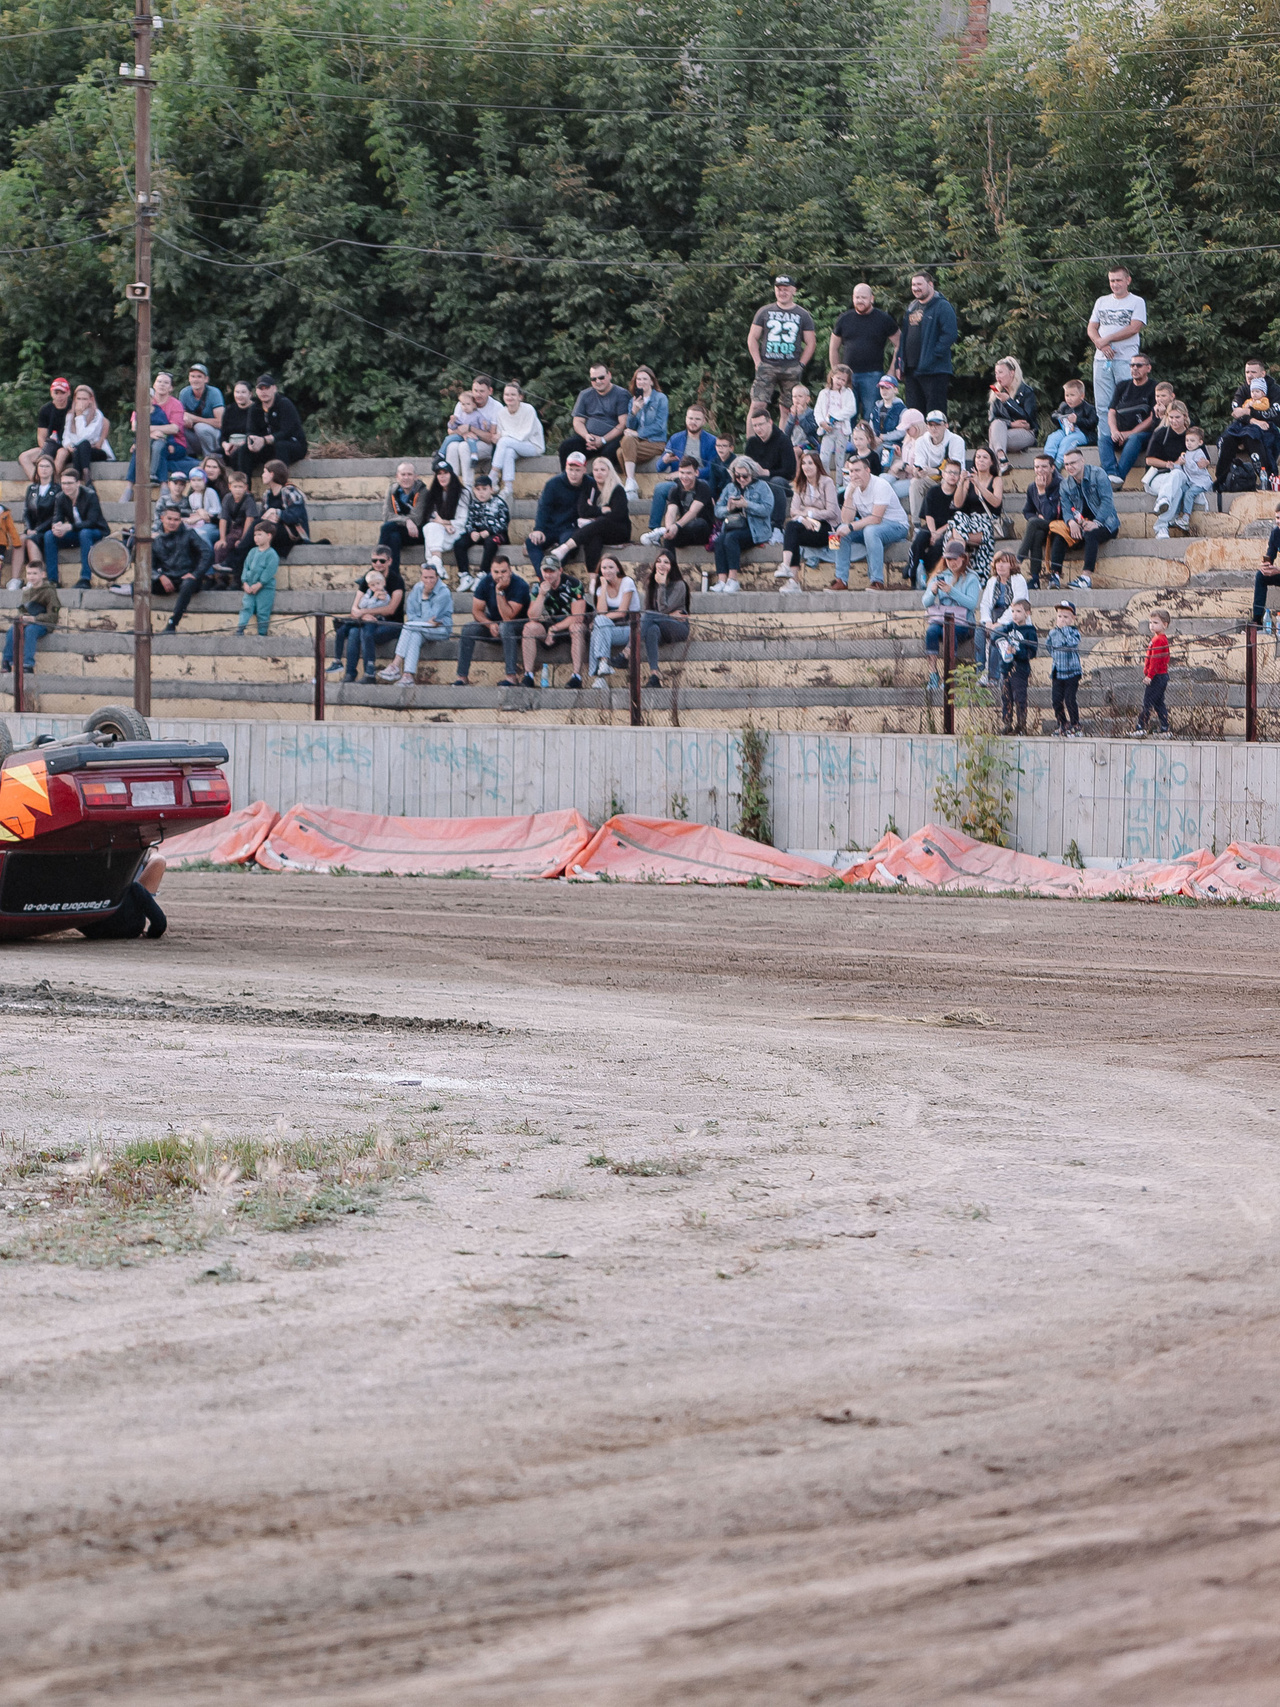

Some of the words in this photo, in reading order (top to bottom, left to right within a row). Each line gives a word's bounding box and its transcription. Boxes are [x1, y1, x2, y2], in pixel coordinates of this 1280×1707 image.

[767, 311, 800, 324] TEAM
[766, 320, 799, 343] 23
[766, 342, 795, 354] STOP
[61, 901, 103, 911] Pandora
